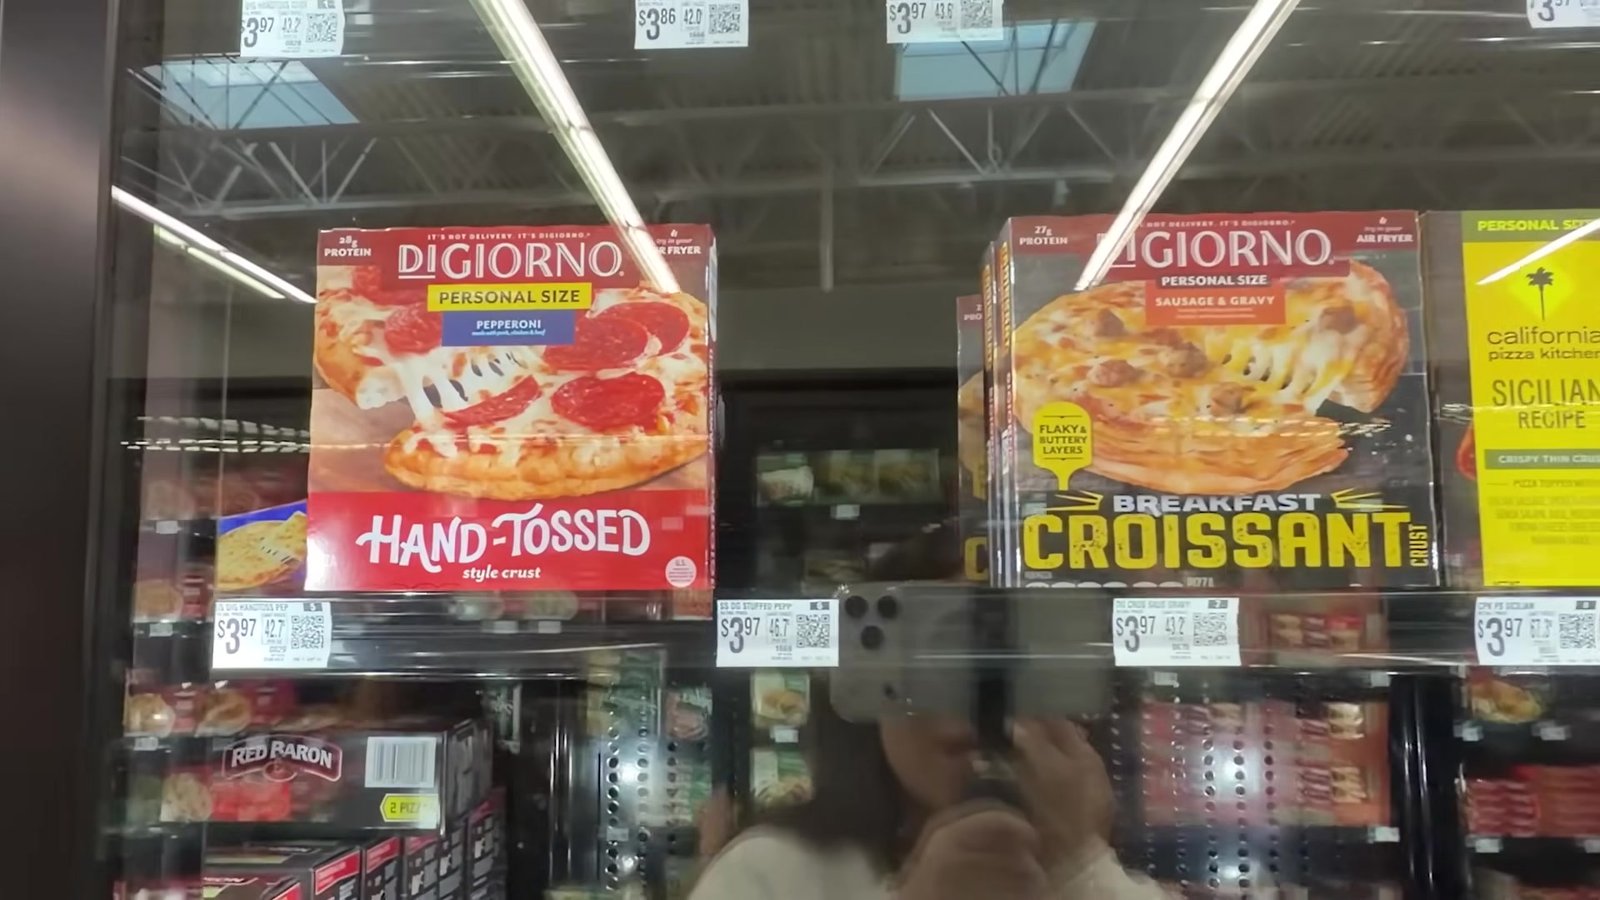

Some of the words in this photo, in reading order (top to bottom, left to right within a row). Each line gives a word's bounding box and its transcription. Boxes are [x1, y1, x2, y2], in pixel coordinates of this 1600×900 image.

[1477, 219, 1560, 231] PERSONAL
[448, 233, 467, 241] NOT
[1019, 236, 1069, 246] PROTEIN
[1356, 233, 1376, 243] AIR
[1377, 233, 1413, 243] FRYER
[324, 247, 372, 257] PROTEIN
[667, 245, 702, 255] FRYER
[1161, 275, 1236, 287] PERSONAL
[1237, 274, 1268, 285] SIZE
[439, 290, 537, 305] PERSONAL
[541, 289, 581, 303] SIZE
[1155, 296, 1215, 307] SAUSAGE
[1218, 296, 1227, 306] &
[1230, 295, 1275, 306] GRAVY
[476, 319, 542, 330] PEPPERONI
[1487, 325, 1600, 345] california
[1488, 348, 1535, 362] pizza
[1491, 378, 1600, 407] SICILIAN
[1518, 410, 1586, 429] RECIPE
[1039, 424, 1079, 434] FLAKY
[1080, 426, 1087, 434] &
[1039, 435, 1088, 444] BUTTERY
[1042, 445, 1083, 455] LAYERS
[1498, 454, 1539, 464] CRISPY
[1541, 454, 1570, 464] THIN
[1113, 493, 1322, 517] BREAKFAST
[355, 502, 651, 574] HAND-TOSSED
[1023, 511, 1411, 569] CROISSANT
[1408, 523, 1429, 567] CRUST
[462, 564, 499, 580] style
[501, 565, 541, 579] crust
[231, 744, 268, 768] RED
[269, 740, 333, 769] BARON
[390, 801, 397, 814] 2
